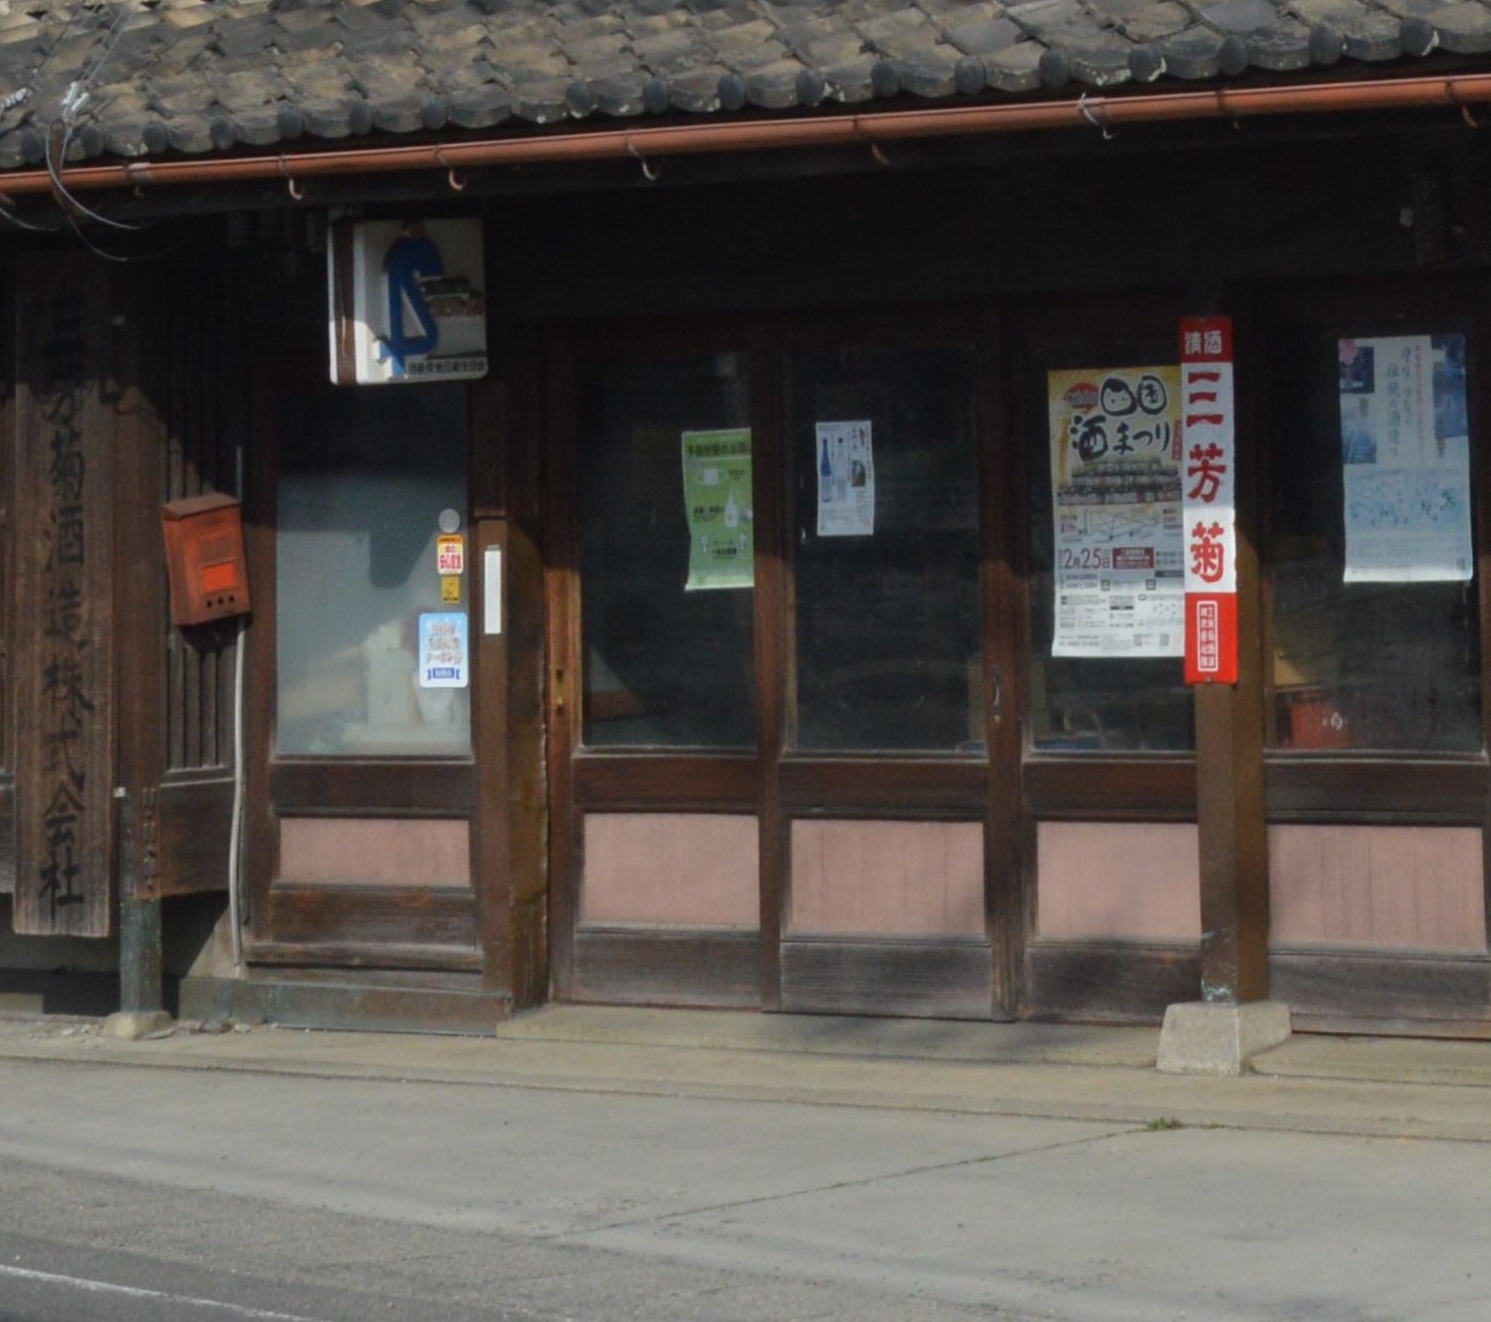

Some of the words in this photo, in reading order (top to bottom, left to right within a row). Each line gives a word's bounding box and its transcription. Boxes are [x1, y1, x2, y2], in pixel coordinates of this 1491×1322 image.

[1184, 330, 1222, 355] 清酒
[1069, 414, 1171, 462] 酒まつり
[1186, 371, 1227, 584] 三芳菊
